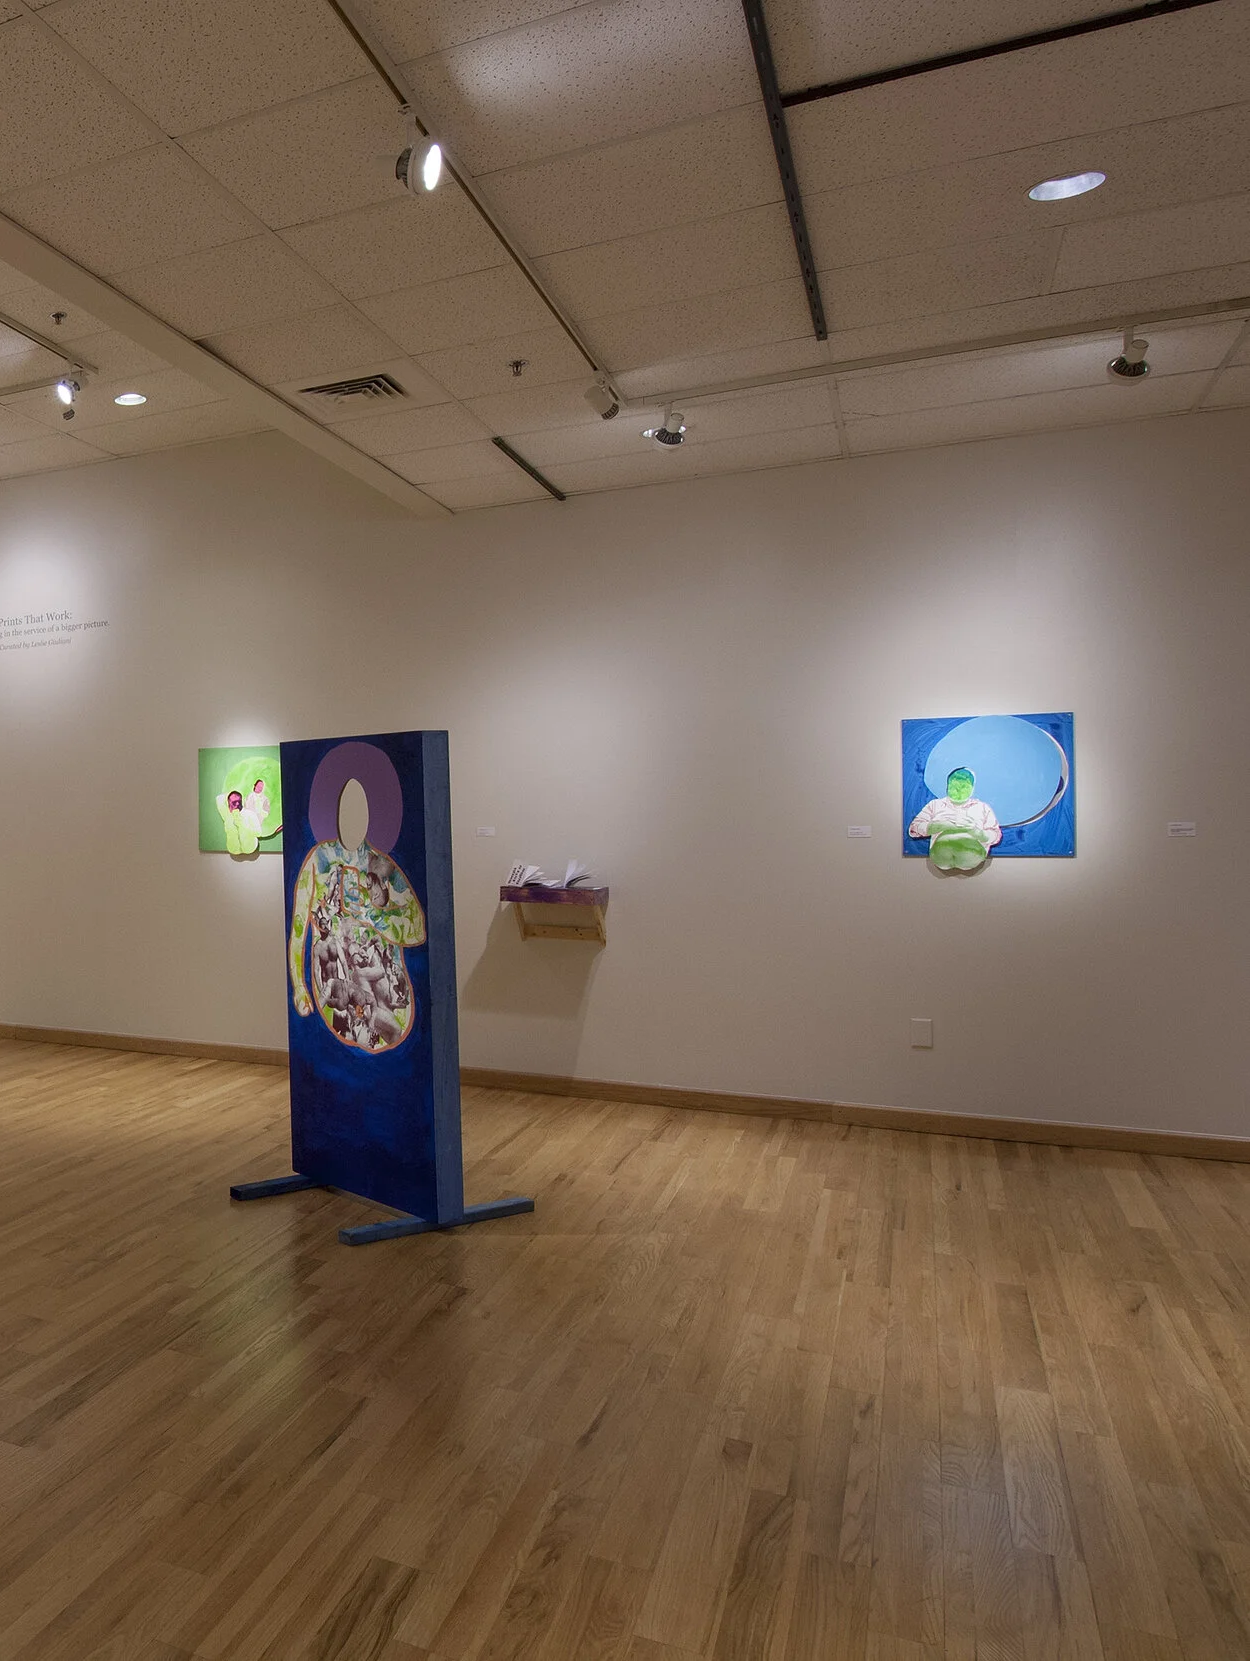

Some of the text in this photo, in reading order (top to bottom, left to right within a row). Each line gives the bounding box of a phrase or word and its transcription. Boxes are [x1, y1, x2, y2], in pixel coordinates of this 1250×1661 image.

[24, 613, 44, 625] That
[46, 610, 73, 622] Work:
[3, 630, 11, 638] in
[12, 628, 23, 637] the
[23, 626, 47, 636] service
[47, 624, 56, 633] of
[61, 622, 83, 632] bigger
[83, 619, 110, 630] picture.
[0, 641, 22, 651] Curated
[22, 641, 30, 650] by
